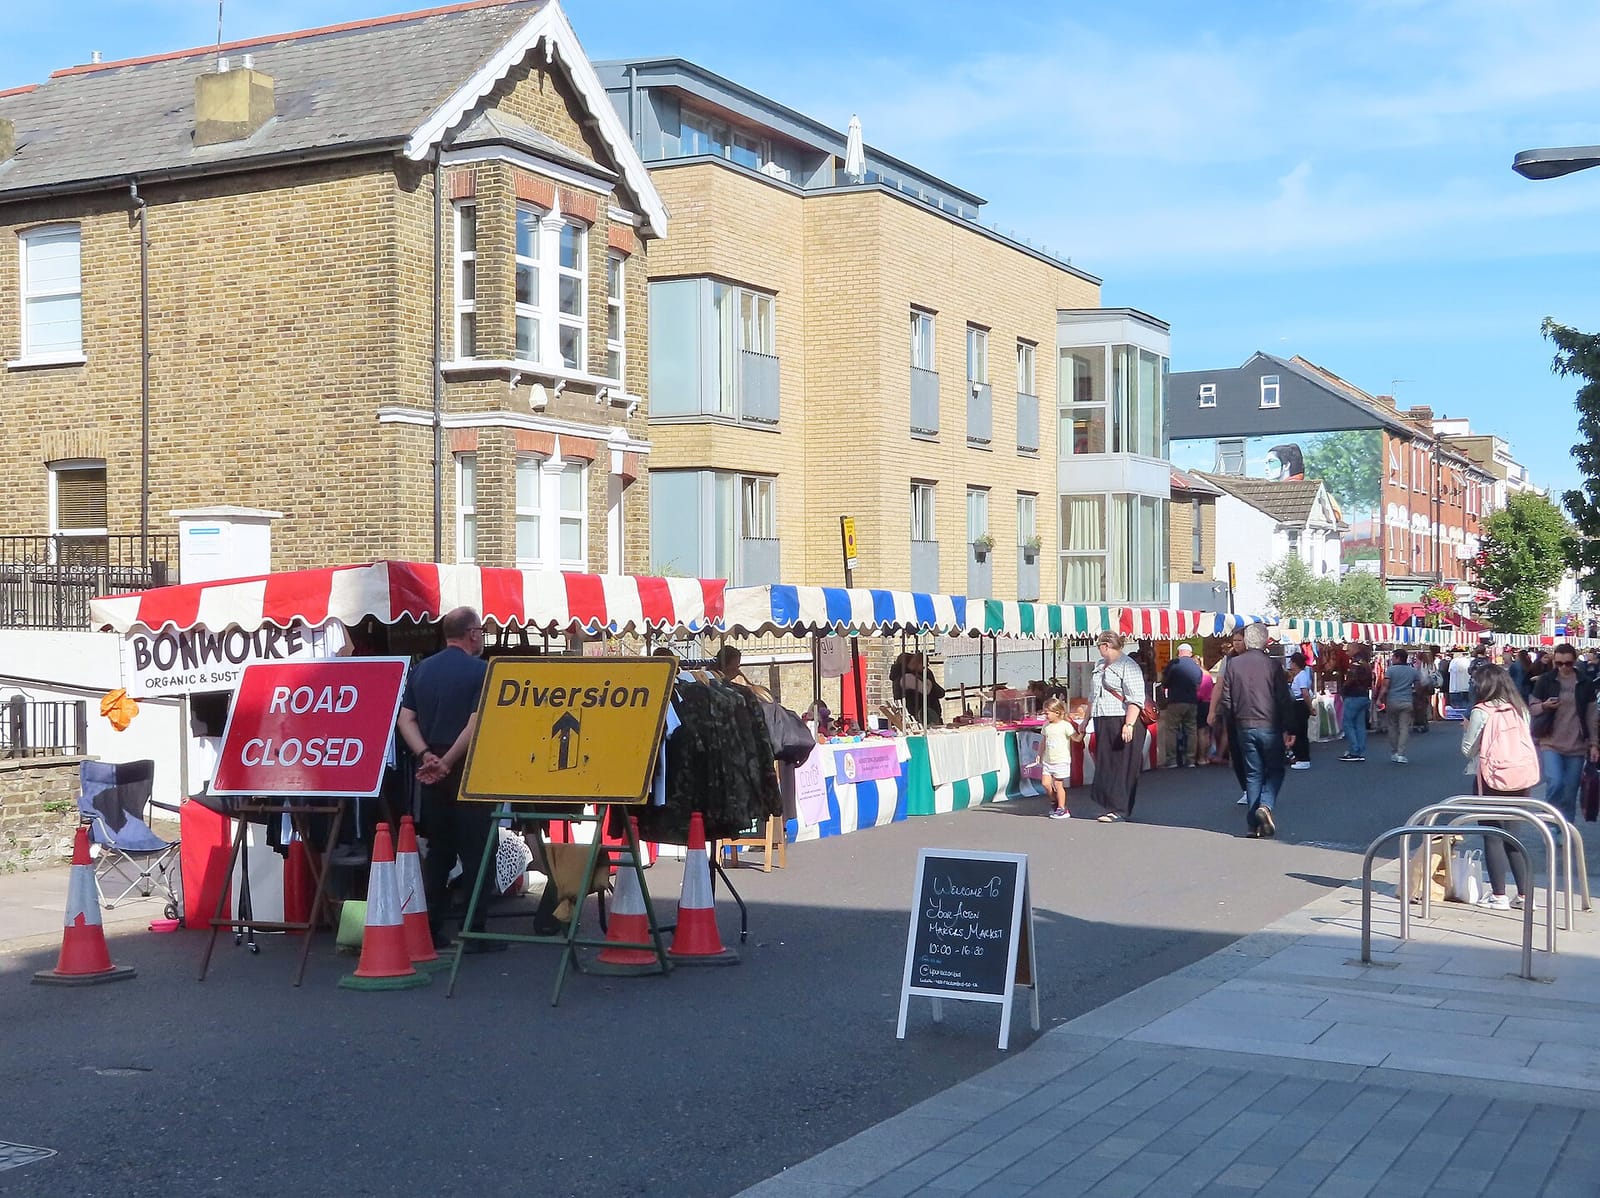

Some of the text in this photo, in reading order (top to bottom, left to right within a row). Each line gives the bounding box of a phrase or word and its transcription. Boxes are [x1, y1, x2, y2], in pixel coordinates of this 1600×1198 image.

[145, 673, 197, 689] ORGANIC
[199, 673, 207, 683] &
[497, 679, 650, 708] Diversion
[269, 685, 359, 715] ROAD
[241, 737, 364, 767] CLOSED
